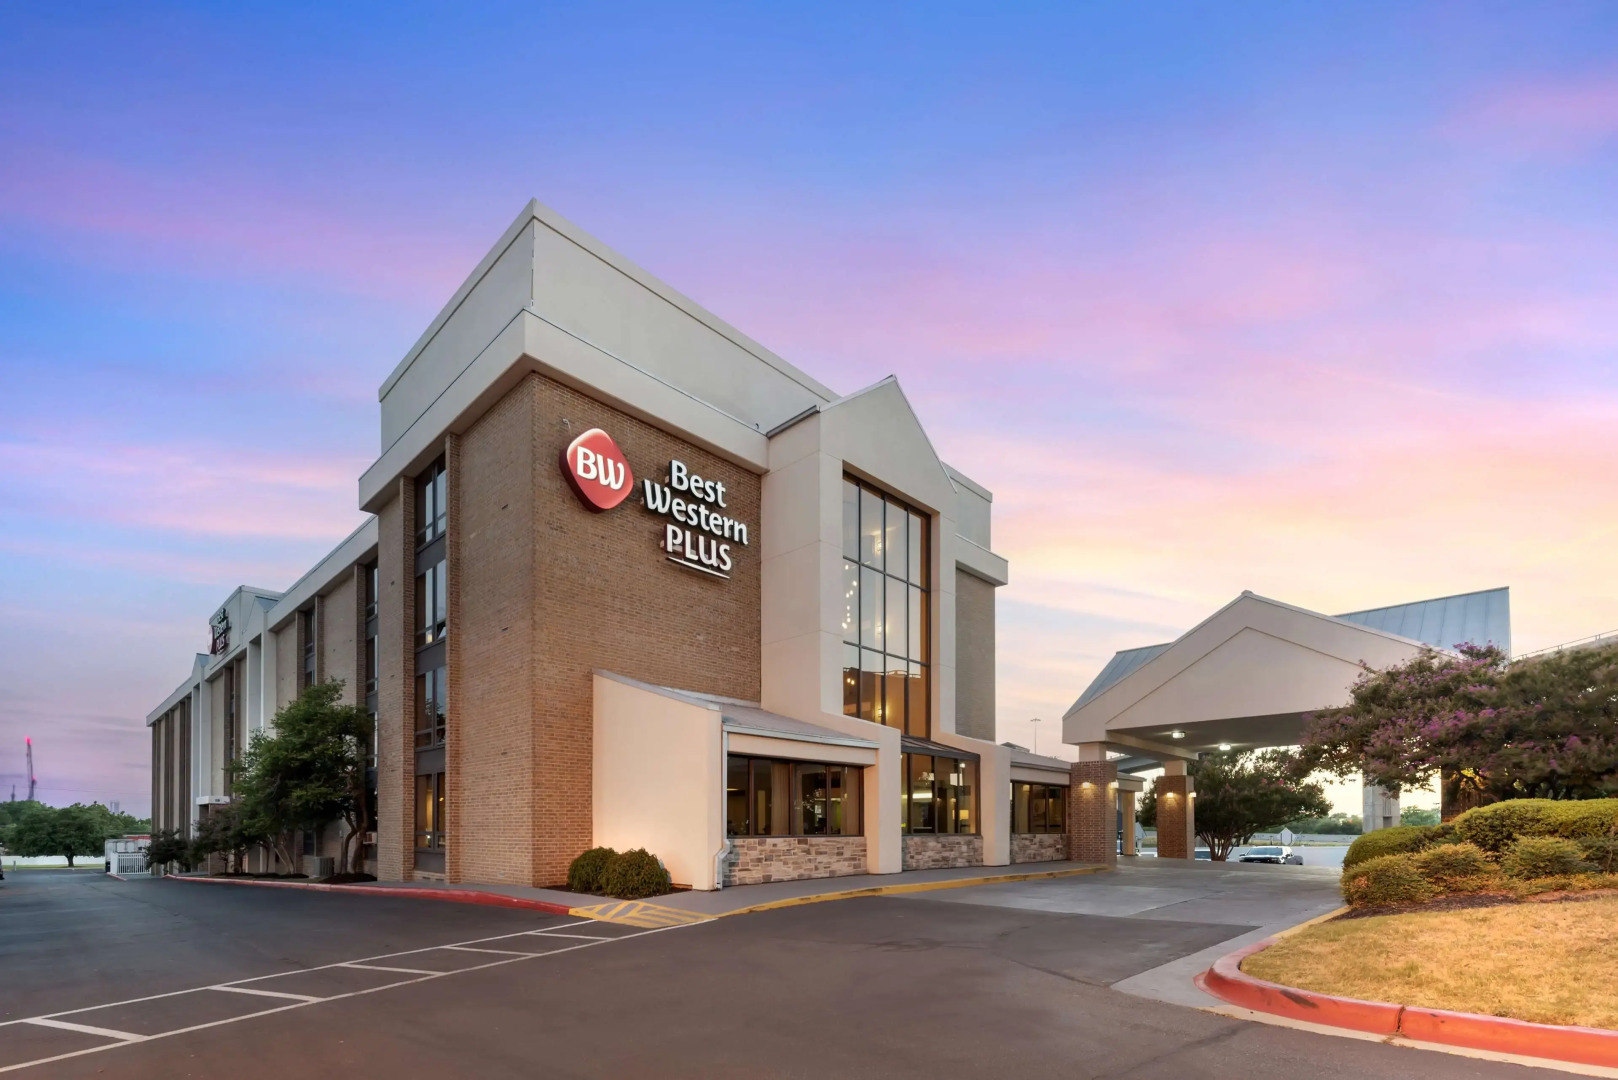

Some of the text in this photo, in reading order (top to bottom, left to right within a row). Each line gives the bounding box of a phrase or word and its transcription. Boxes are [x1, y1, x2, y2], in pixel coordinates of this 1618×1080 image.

[576, 446, 625, 490] BW
[670, 459, 727, 507] Best
[643, 479, 748, 545] Western
[666, 523, 732, 571] PLUS
